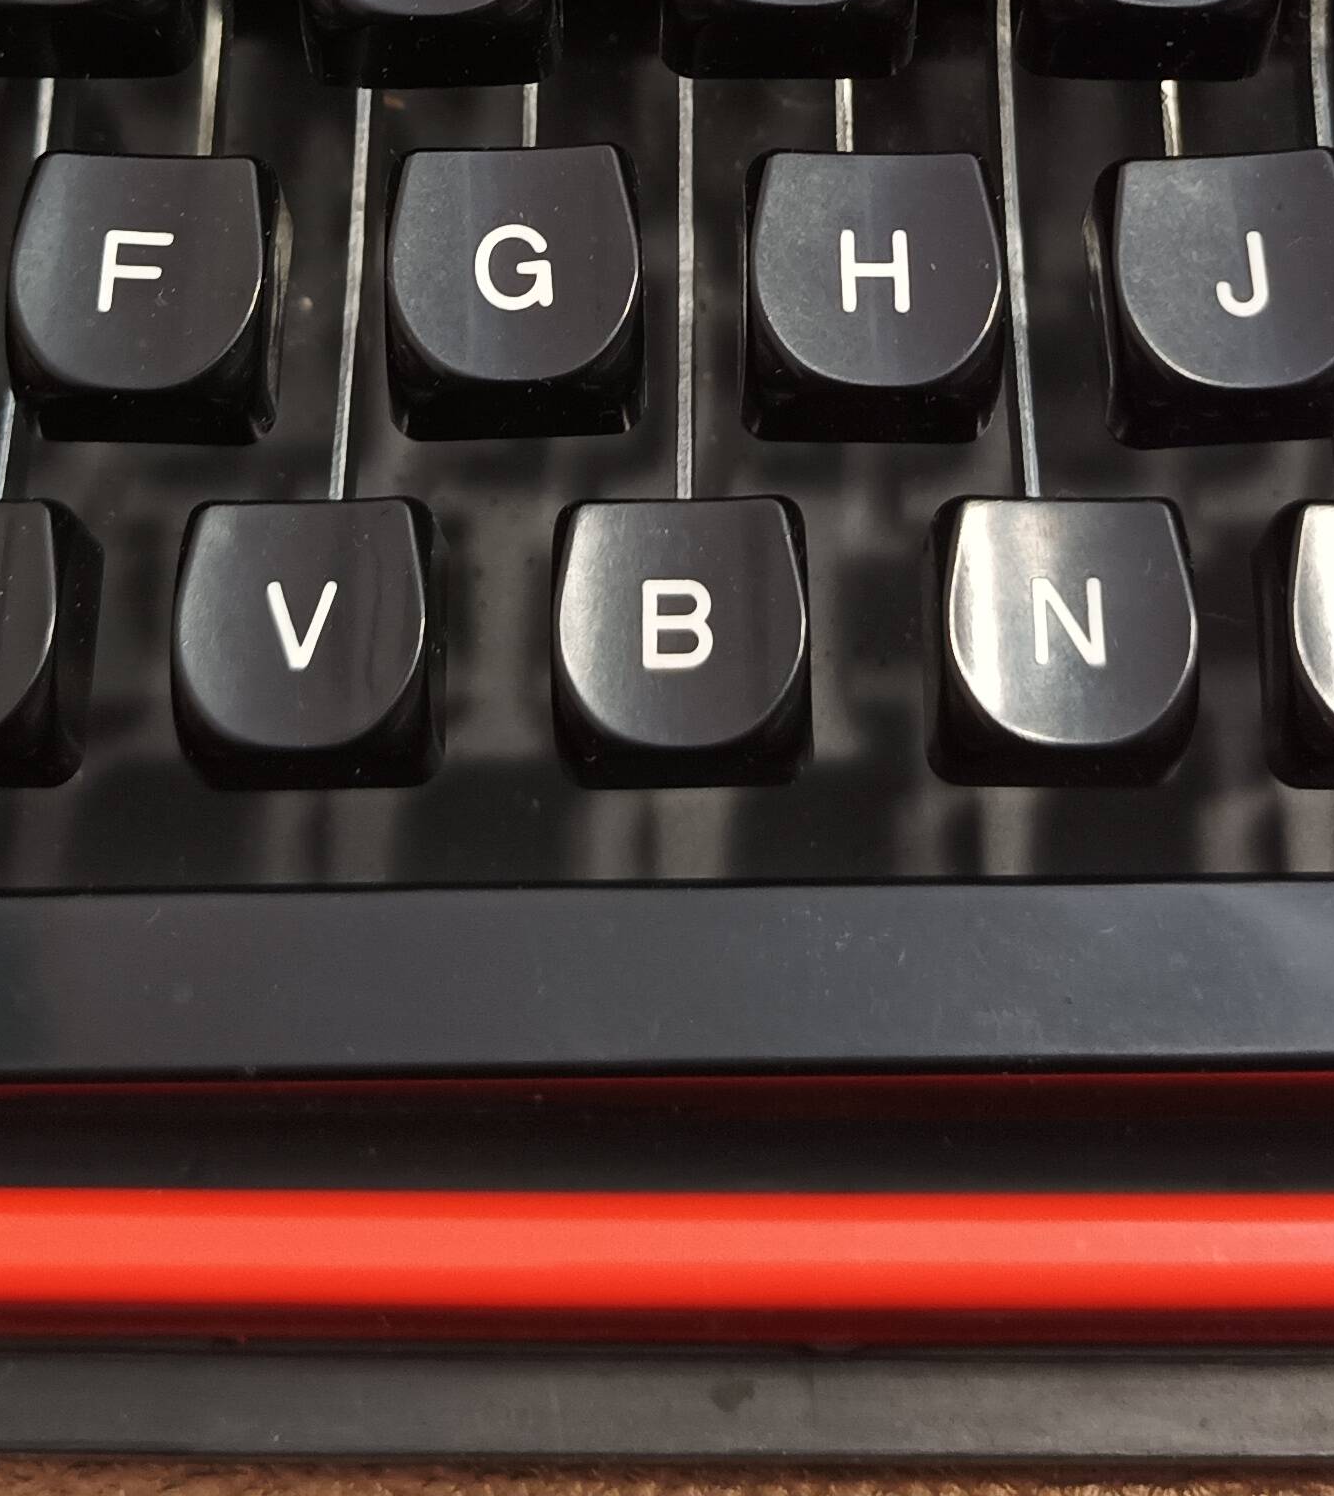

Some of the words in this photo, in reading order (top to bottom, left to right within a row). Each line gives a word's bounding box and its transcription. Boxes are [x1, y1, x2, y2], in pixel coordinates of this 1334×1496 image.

[96, 228, 176, 314] F
[473, 222, 555, 312] G
[839, 228, 912, 315] H
[1214, 229, 1270, 319] J
[265, 579, 339, 671] V
[640, 578, 715, 671] B
[1030, 575, 1108, 667] N
